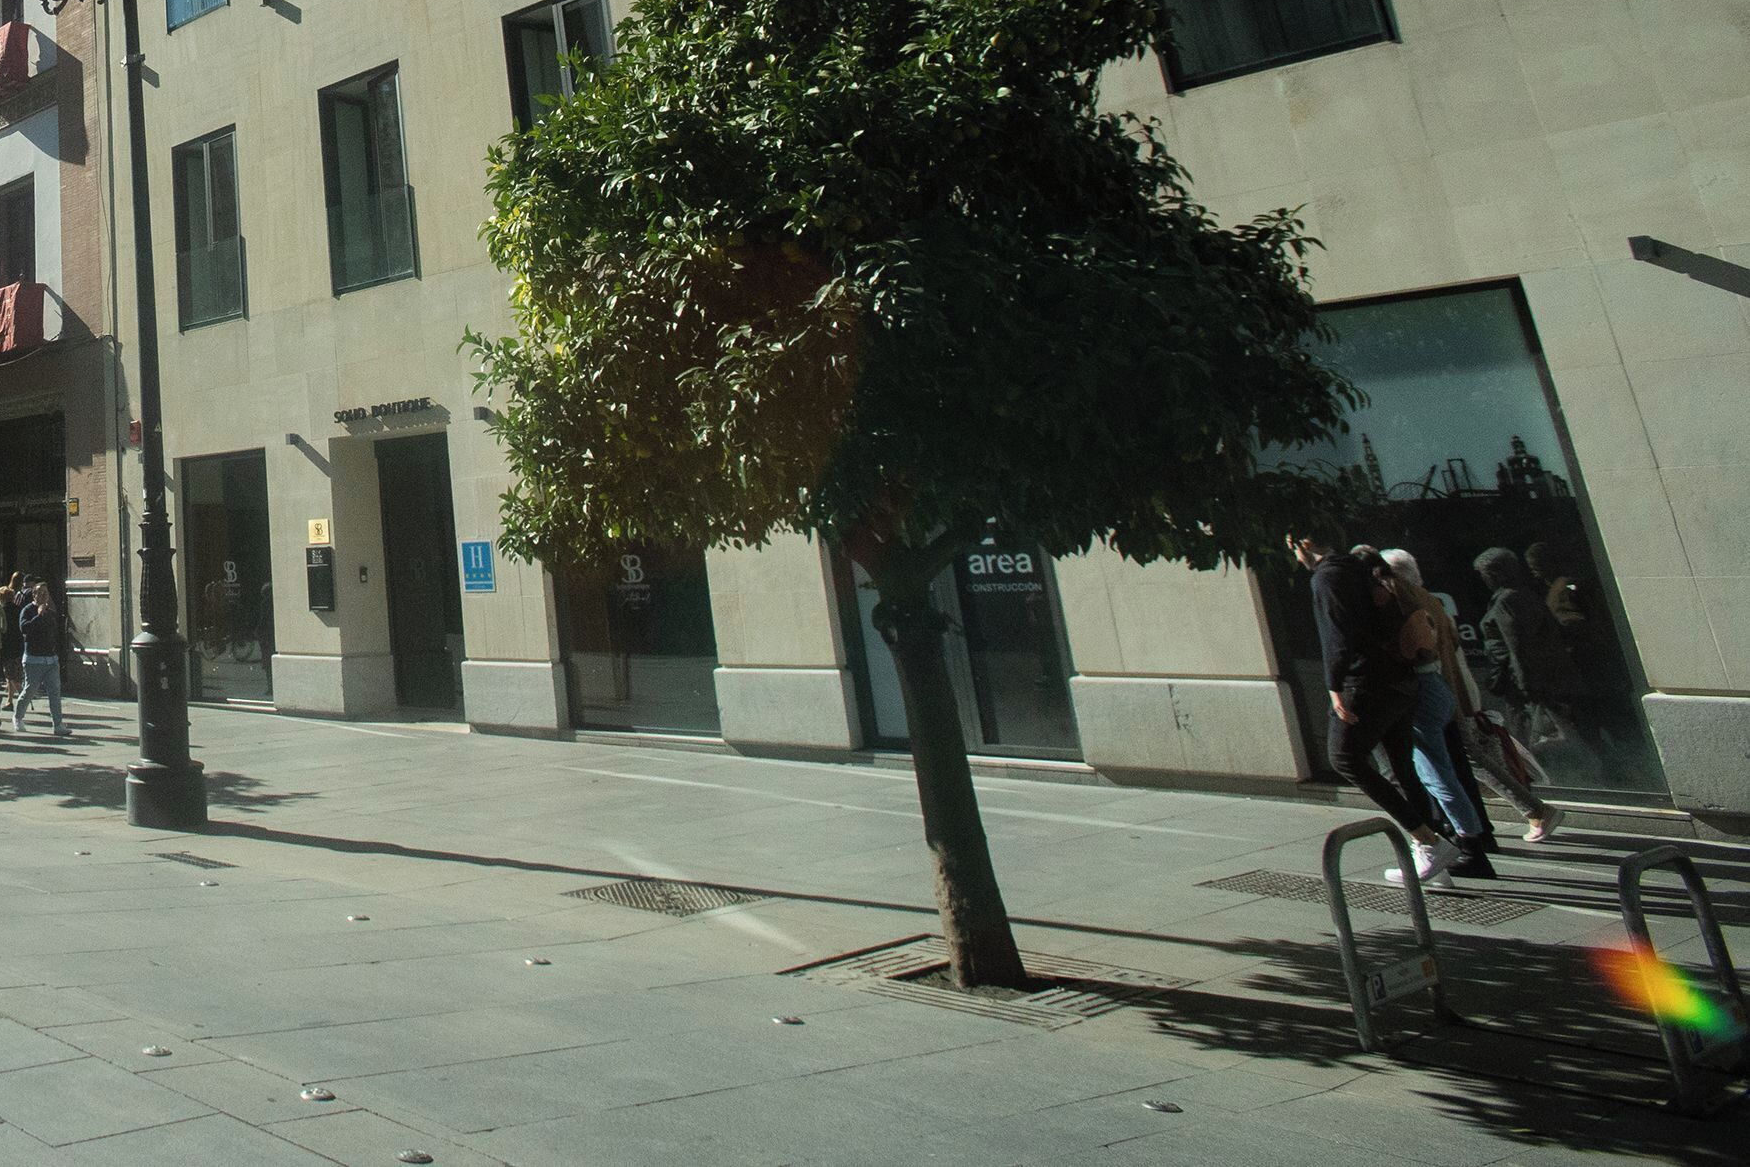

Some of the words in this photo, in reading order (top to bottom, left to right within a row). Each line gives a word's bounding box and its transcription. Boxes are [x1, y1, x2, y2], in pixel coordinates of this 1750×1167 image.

[469, 545, 484, 569] H
[967, 552, 1035, 575] area
[1372, 975, 1383, 999] P
